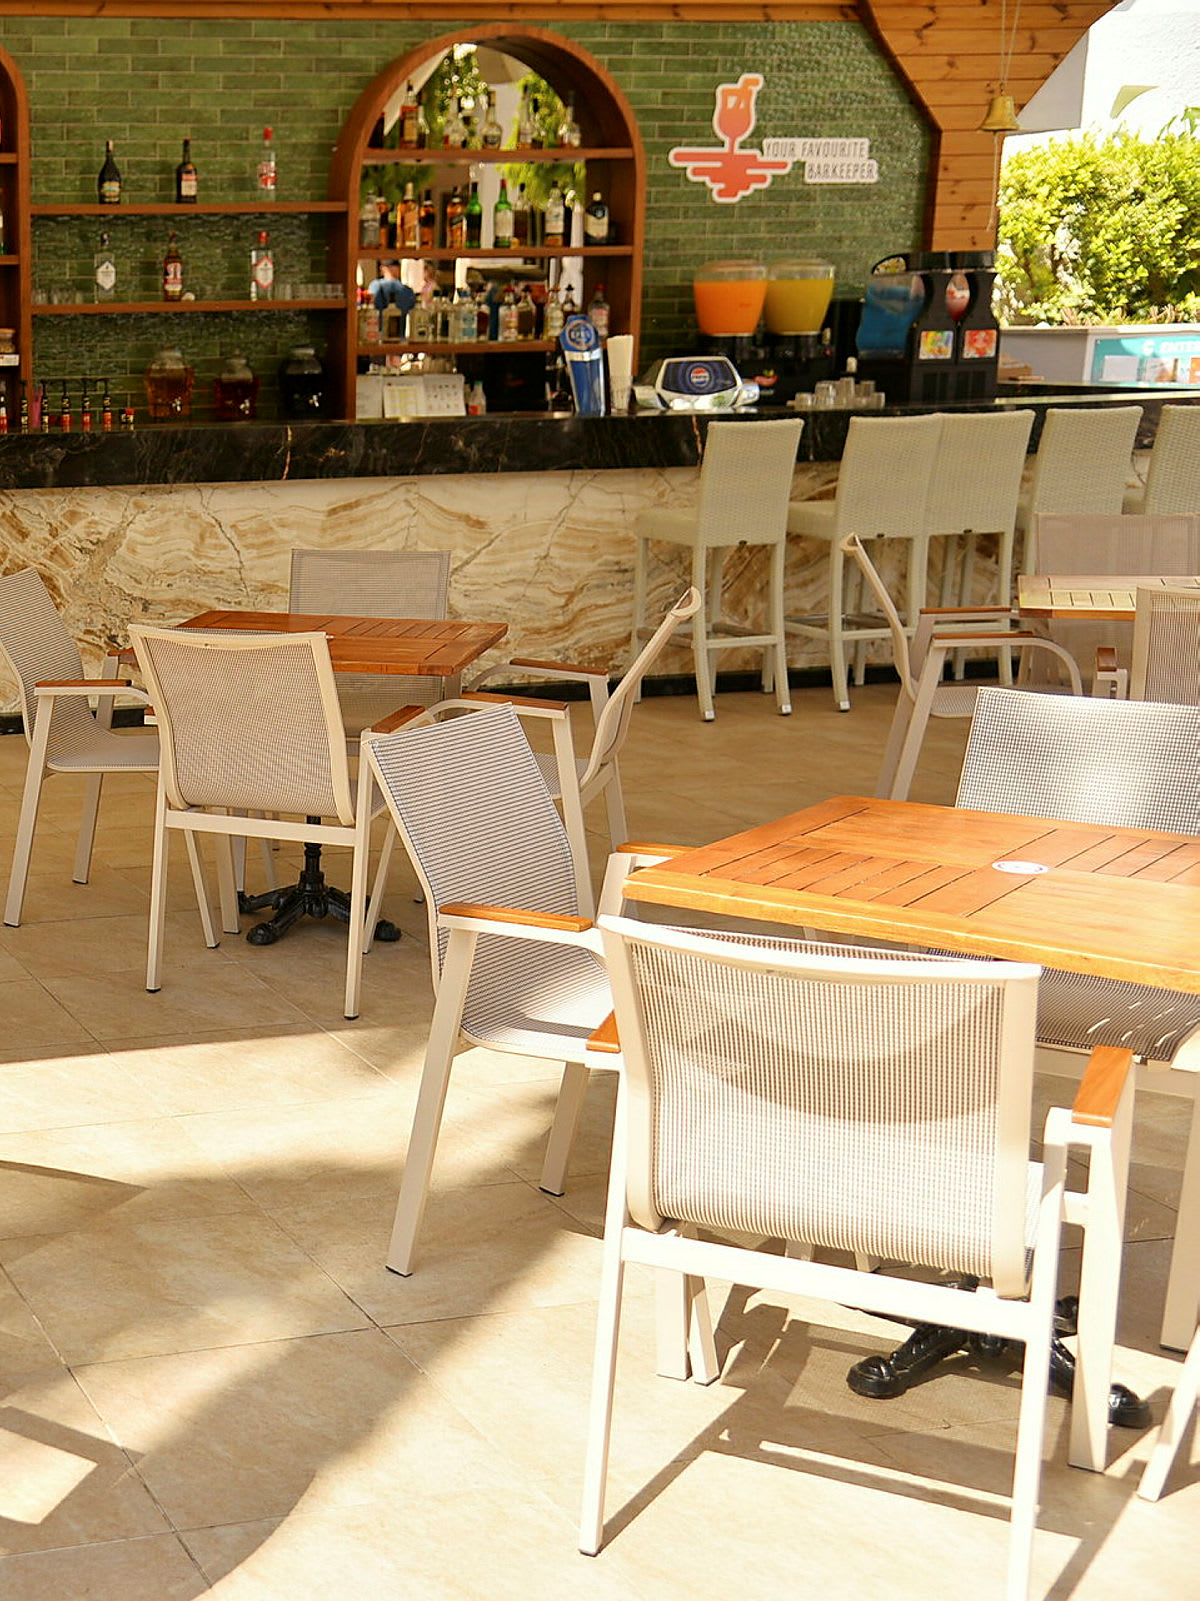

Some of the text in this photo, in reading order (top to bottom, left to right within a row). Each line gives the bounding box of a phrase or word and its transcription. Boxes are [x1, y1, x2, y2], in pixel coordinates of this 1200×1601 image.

[765, 141, 866, 158] YOUR FAVOURITE
[807, 162, 876, 180] BARKEEPER
